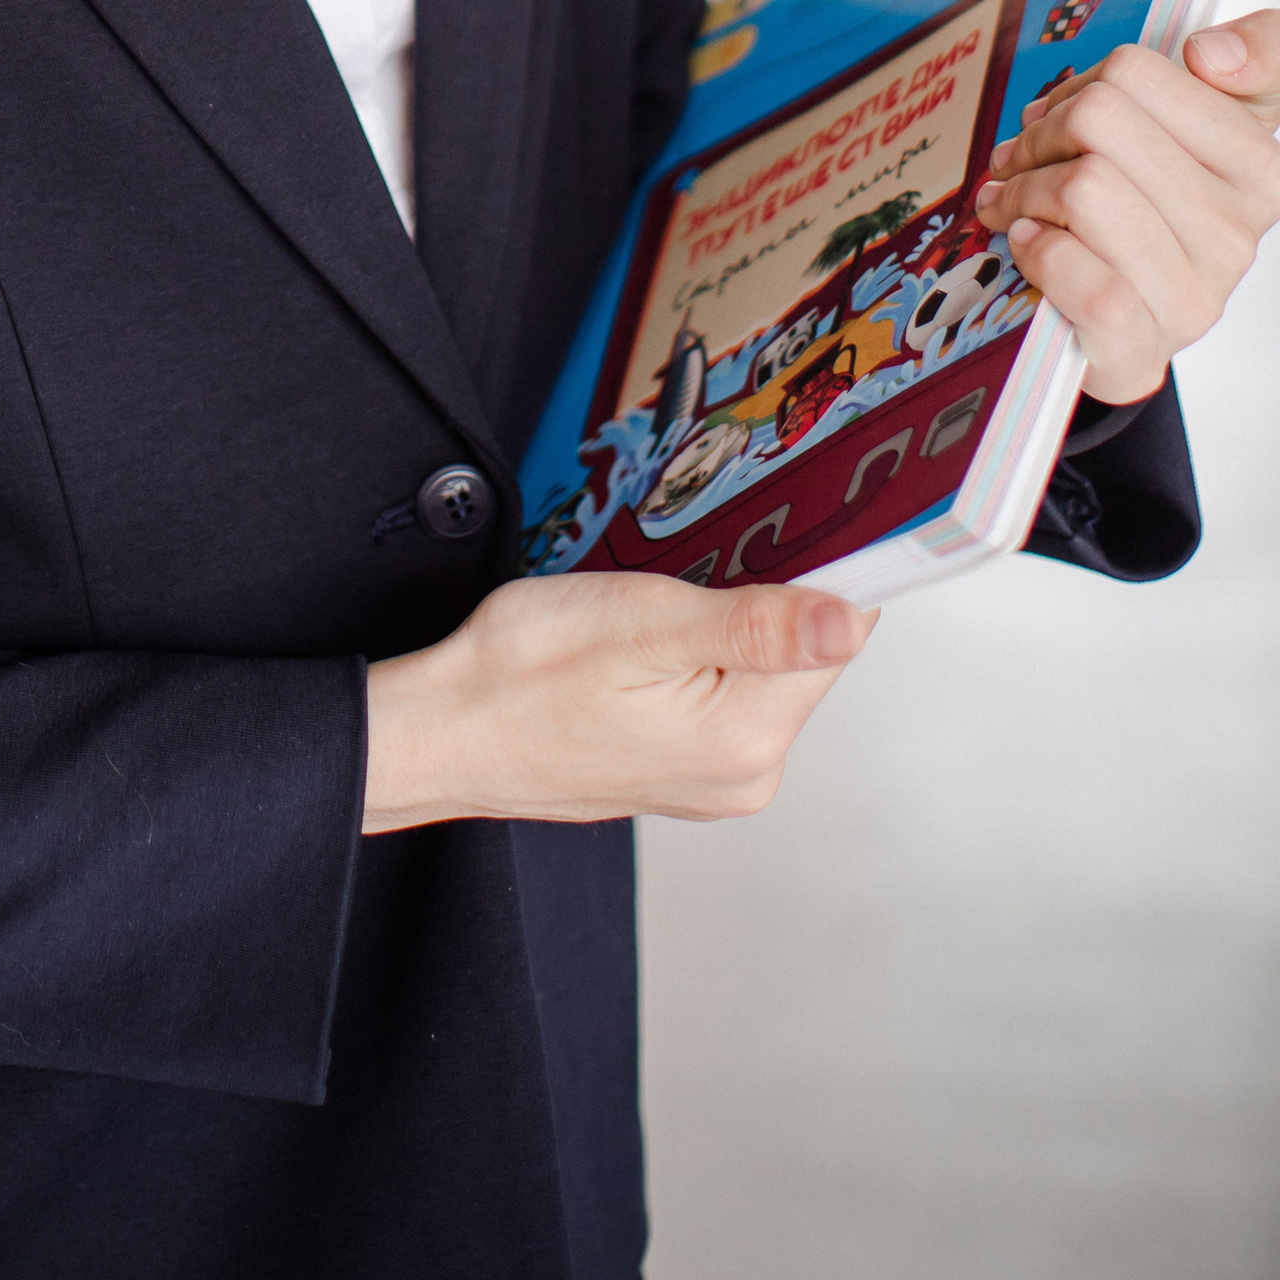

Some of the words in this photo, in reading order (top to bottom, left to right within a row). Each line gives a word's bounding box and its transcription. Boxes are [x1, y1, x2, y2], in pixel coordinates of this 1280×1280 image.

[672, 215, 819, 313] Страны
[833, 132, 944, 210] мира
[682, 27, 982, 238] ЭНЦИКЛОПЕДИЯ
[686, 74, 956, 268] ПУТЕШЕСТВИЙ
